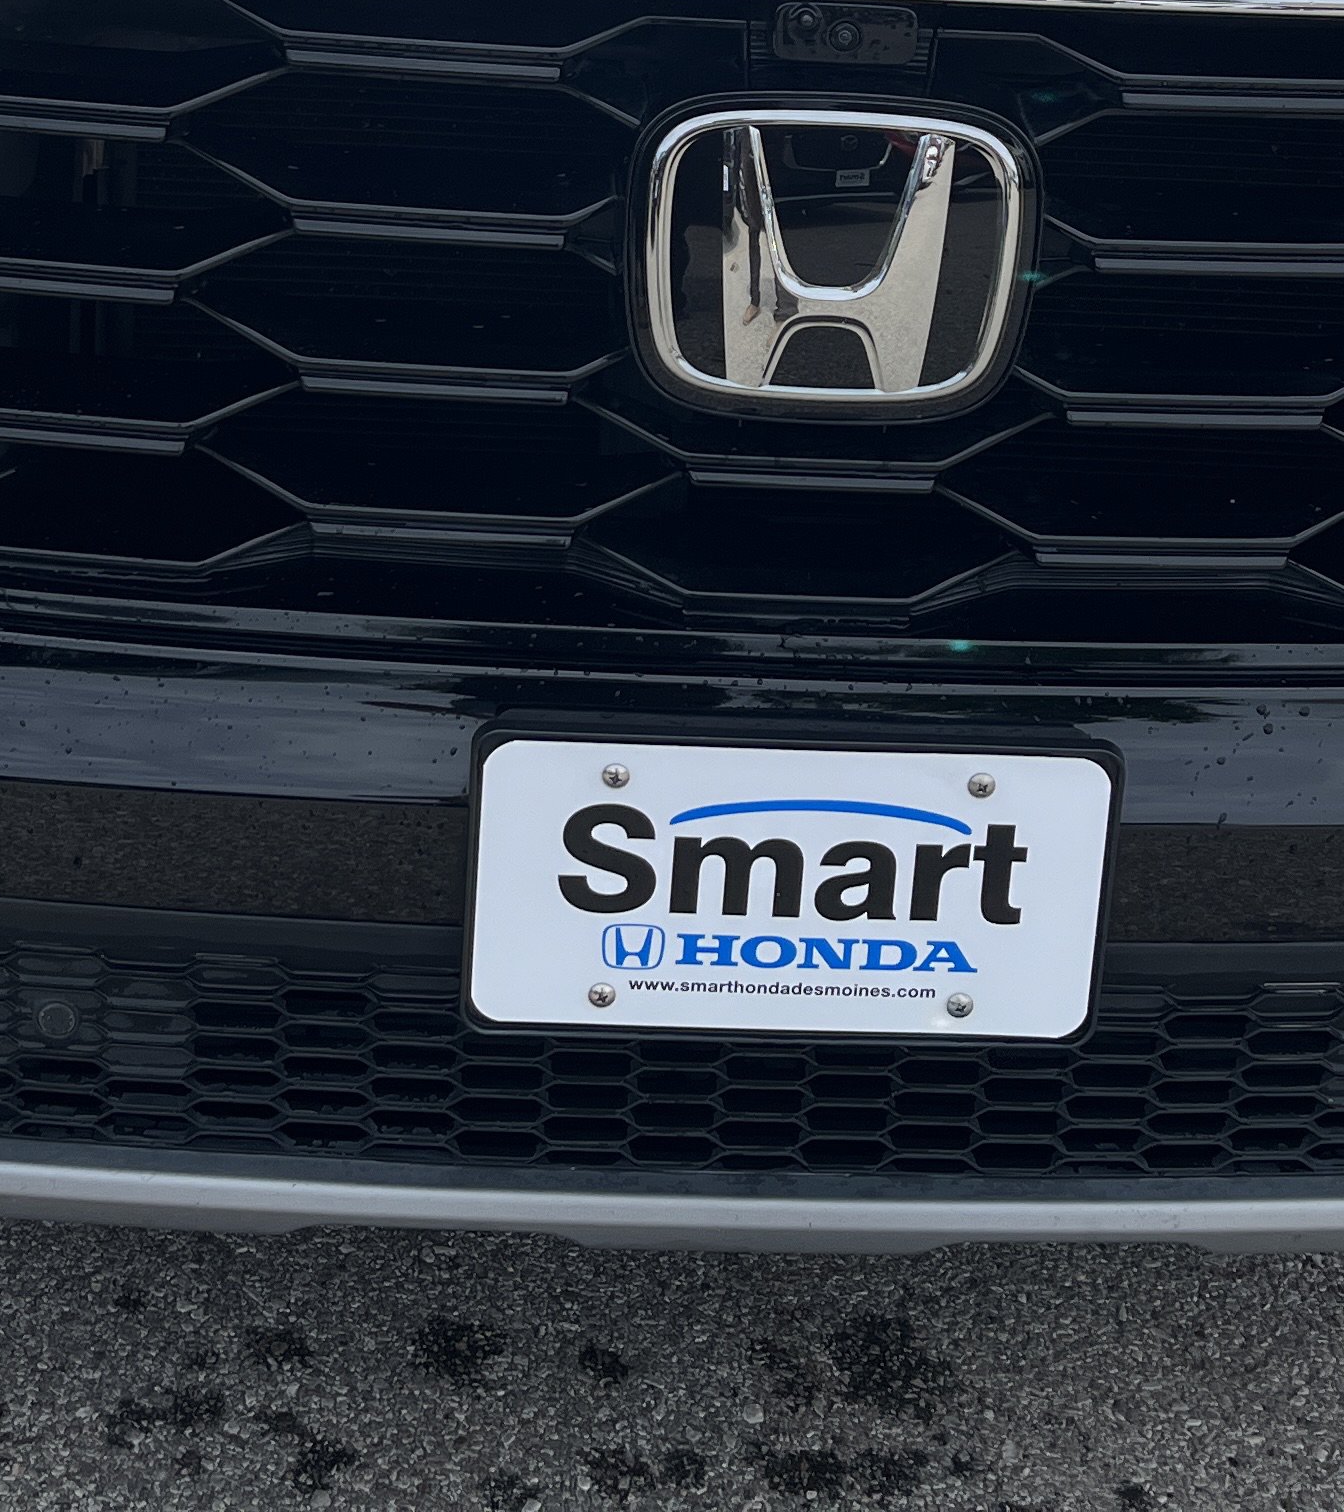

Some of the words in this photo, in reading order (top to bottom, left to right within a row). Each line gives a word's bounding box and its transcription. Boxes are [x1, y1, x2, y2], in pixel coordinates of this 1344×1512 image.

[557, 802, 1028, 925] Smart
[675, 933, 977, 974] HONDA
[628, 976, 936, 1000] www.smarthondadesmoines.com
